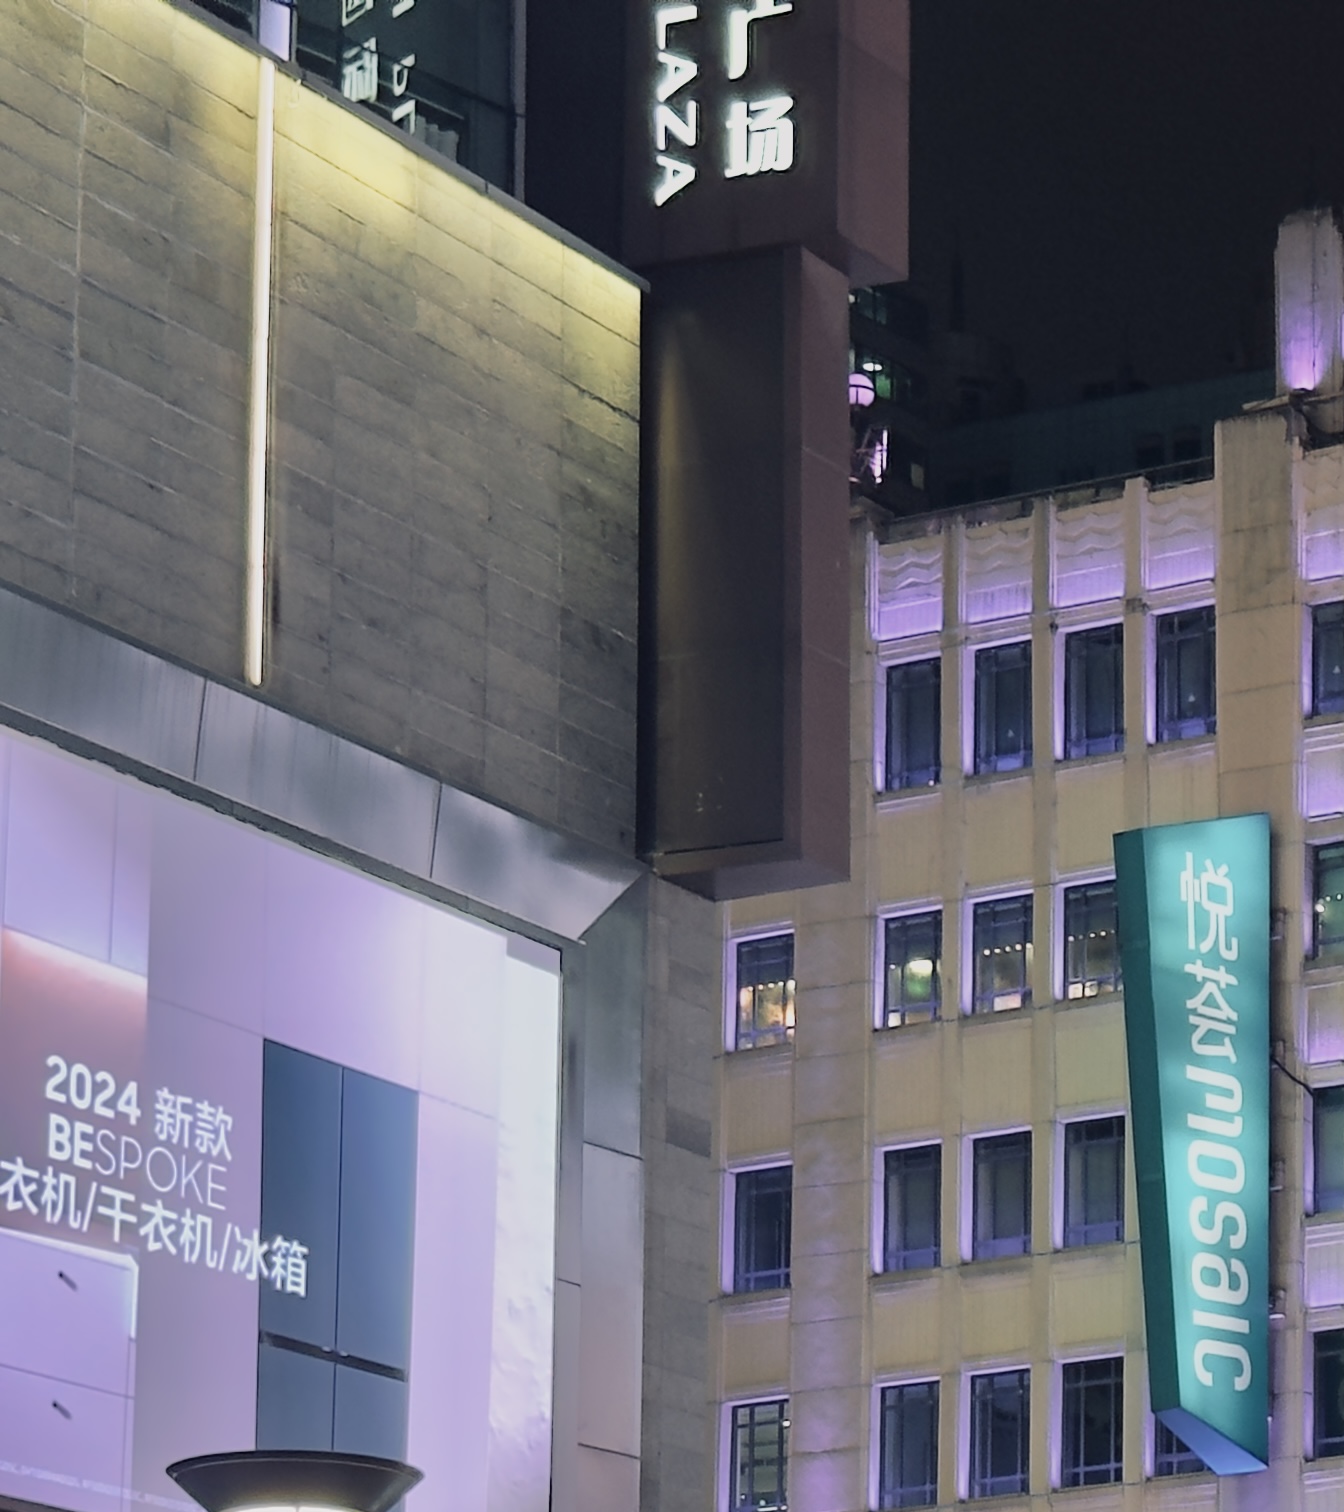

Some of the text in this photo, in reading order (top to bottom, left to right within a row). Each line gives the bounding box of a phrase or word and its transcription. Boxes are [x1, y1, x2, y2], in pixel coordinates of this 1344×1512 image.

[655, 4, 698, 207] LAZA
[45, 1055, 233, 1162] 2024 新款
[49, 1113, 227, 1210] BESPOKE
